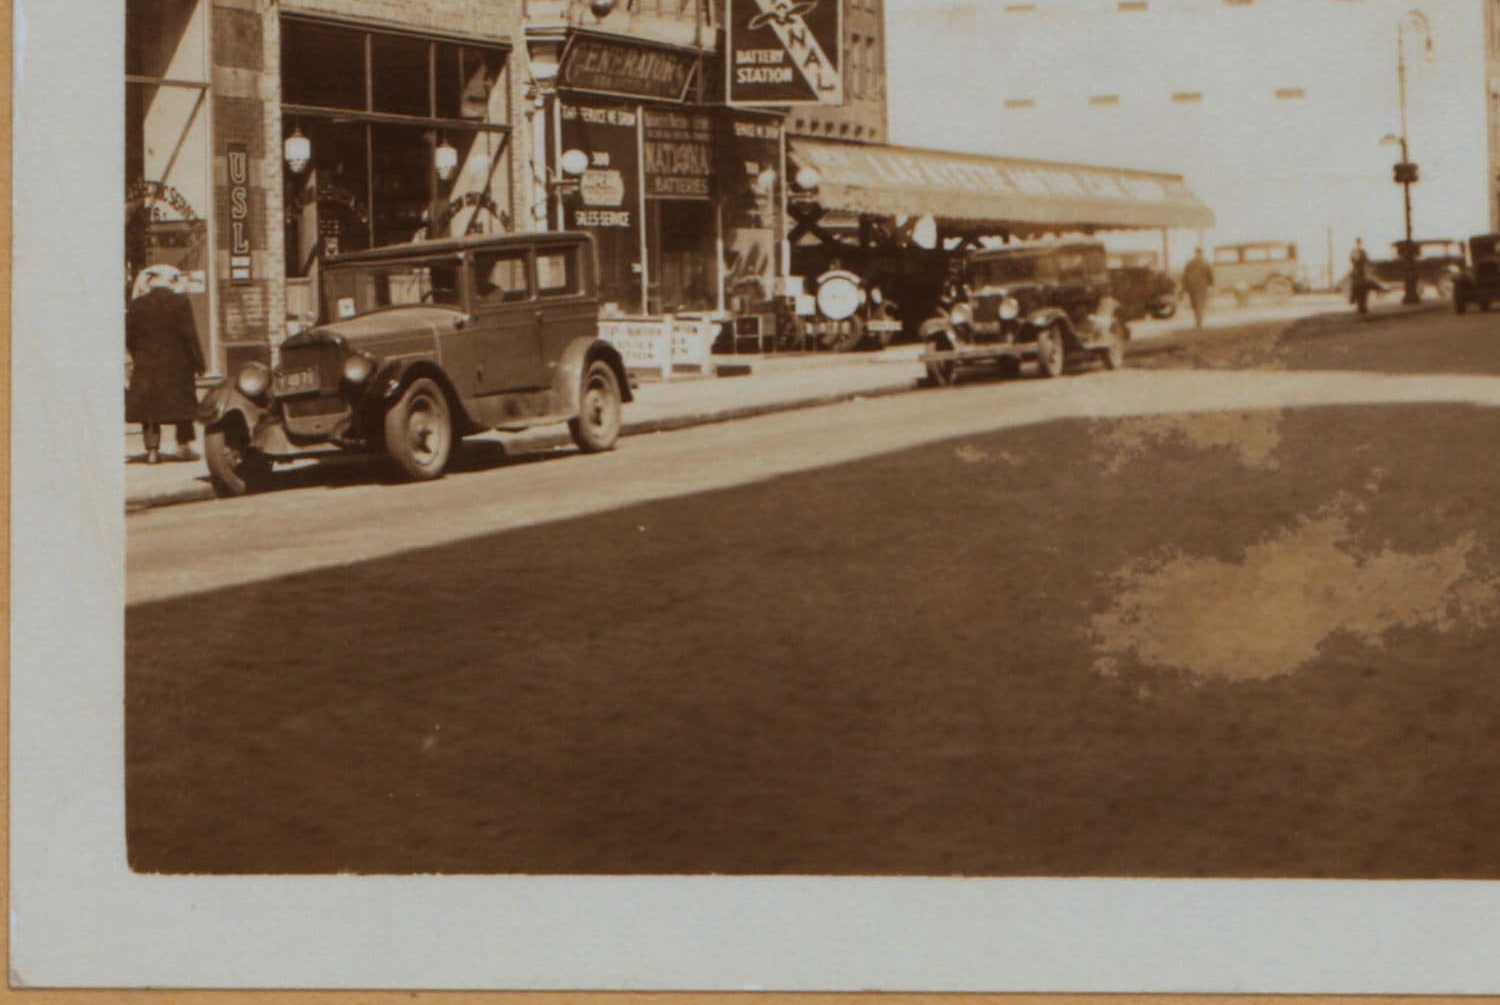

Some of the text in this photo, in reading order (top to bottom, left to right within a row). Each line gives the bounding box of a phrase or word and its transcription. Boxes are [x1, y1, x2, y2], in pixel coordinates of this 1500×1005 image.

[736, 49, 784, 65] BATTERY
[737, 67, 793, 84] STATION
[229, 152, 249, 255] USL
